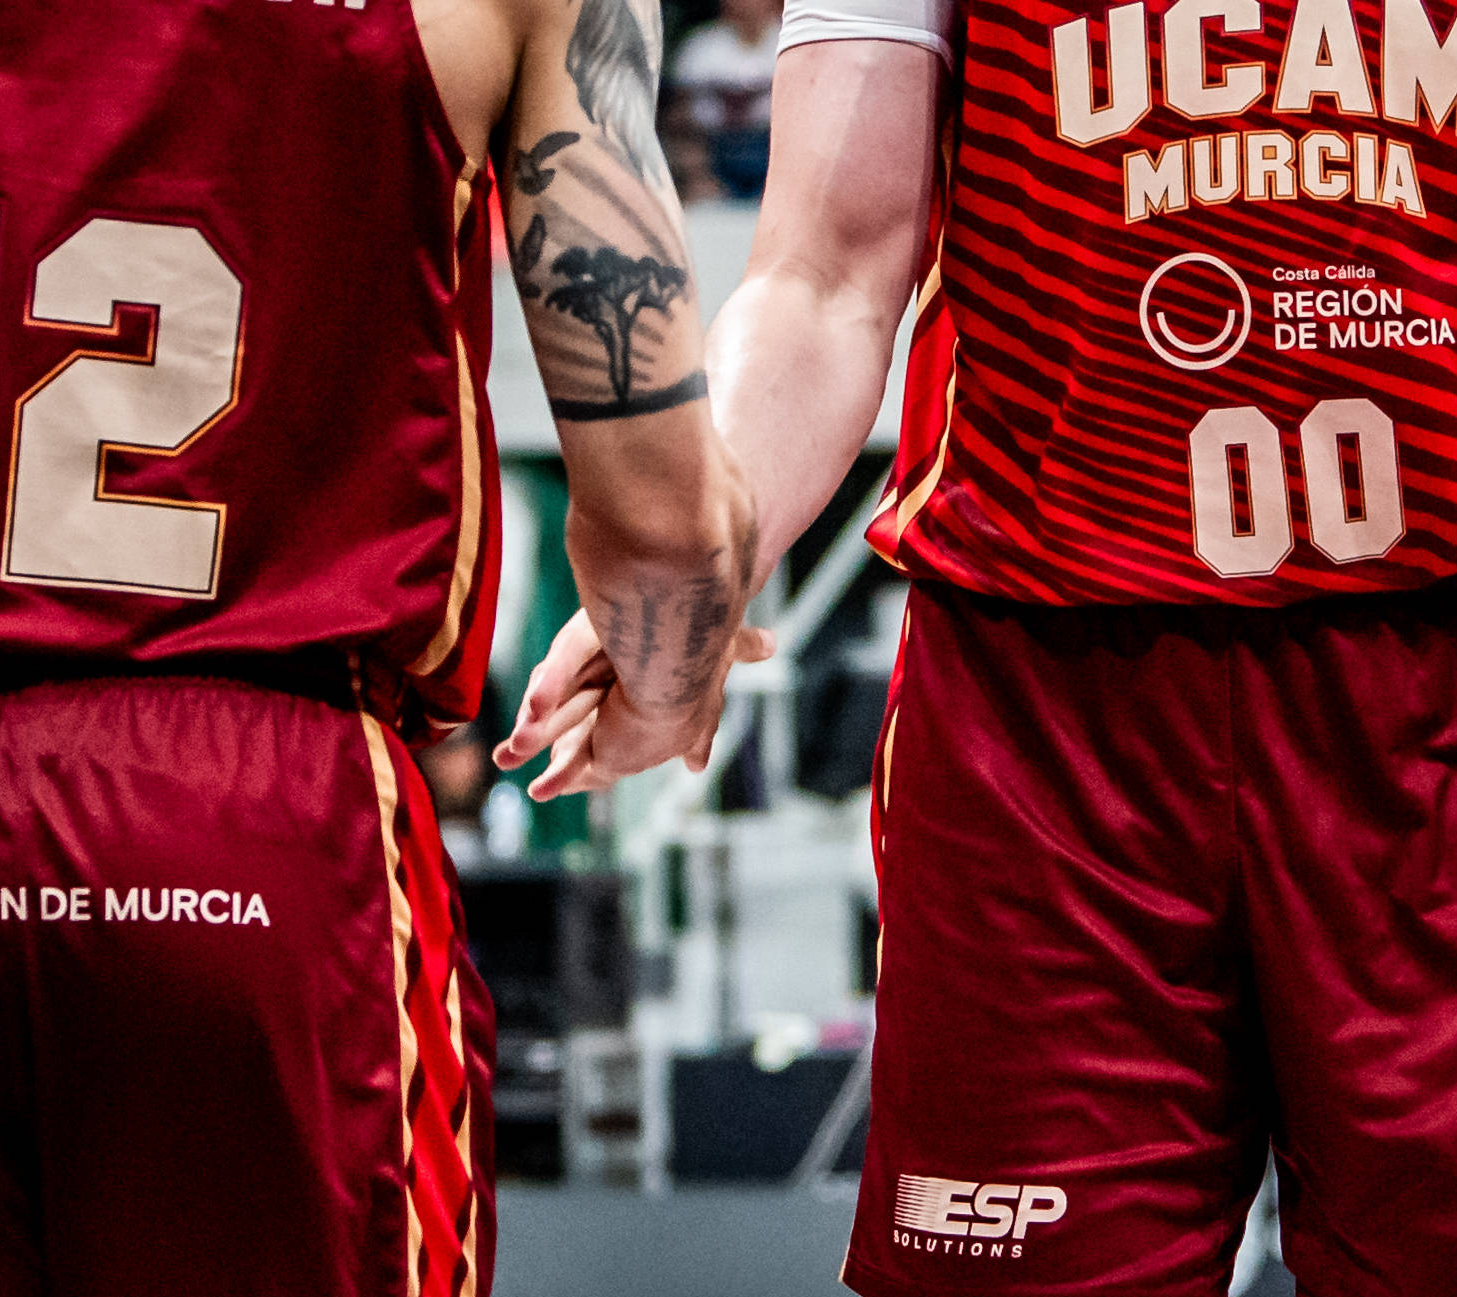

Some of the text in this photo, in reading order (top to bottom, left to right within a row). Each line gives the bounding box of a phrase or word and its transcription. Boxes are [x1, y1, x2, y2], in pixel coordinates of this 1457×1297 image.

[1123, 129, 1428, 226] MURCIA
[1272, 265, 1376, 281] Costa Cálida
[1273, 284, 1402, 319] REGIÓN
[1274, 317, 1456, 350] DE MURCIA
[1188, 398, 1408, 580] 00
[40, 887, 91, 922] DE
[104, 887, 271, 927] MURCIA
[899, 1175, 1068, 1240] ESP
[893, 1229, 1024, 1259] SOLUTIONS
